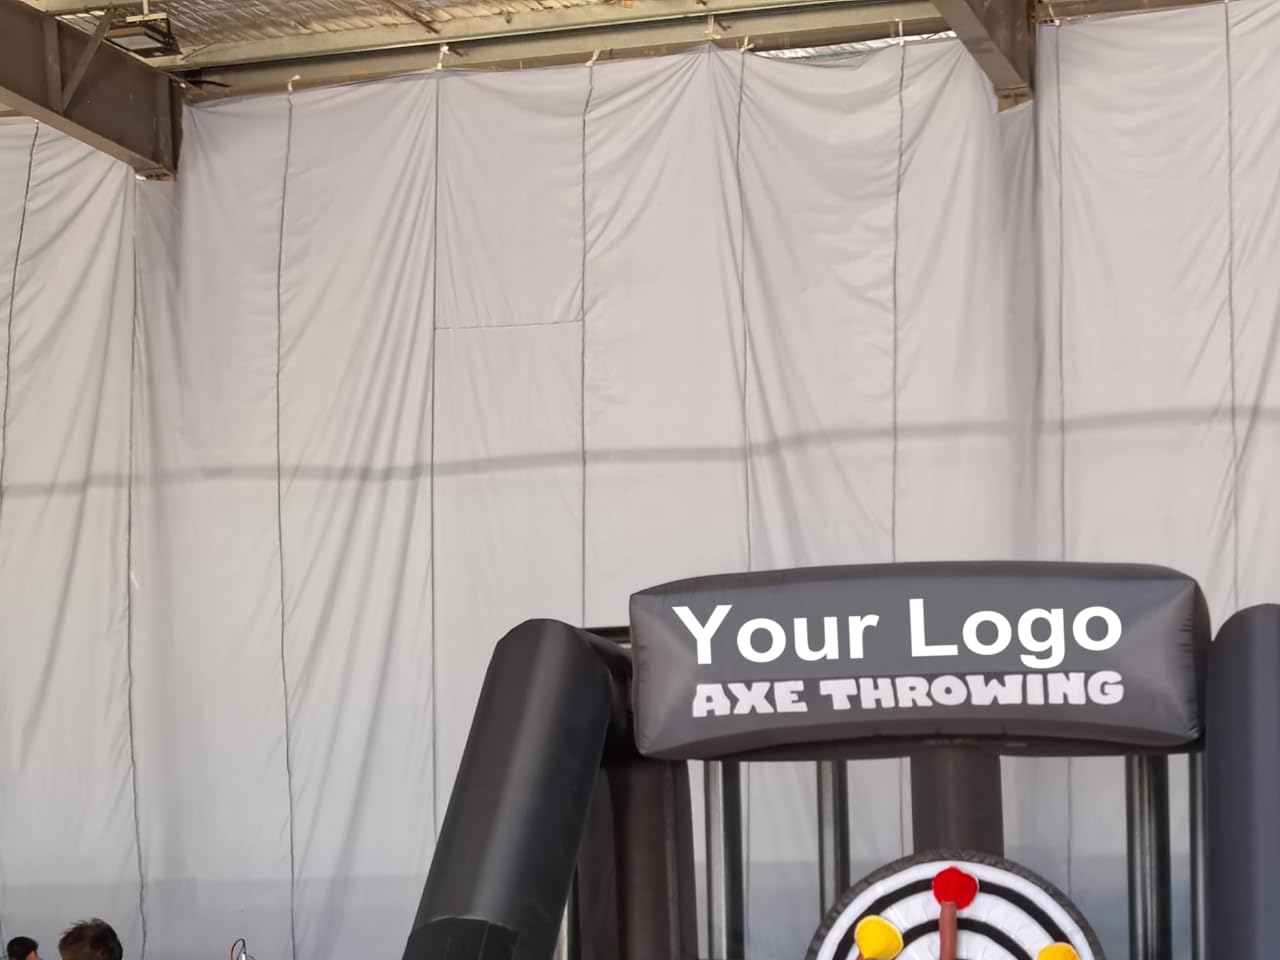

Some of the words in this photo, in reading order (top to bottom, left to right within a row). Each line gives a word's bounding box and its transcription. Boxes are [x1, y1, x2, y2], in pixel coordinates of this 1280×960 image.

[672, 603, 880, 665] Your
[909, 598, 1123, 669] Logo
[692, 679, 809, 718] AXE
[819, 670, 1125, 711] THROWING
